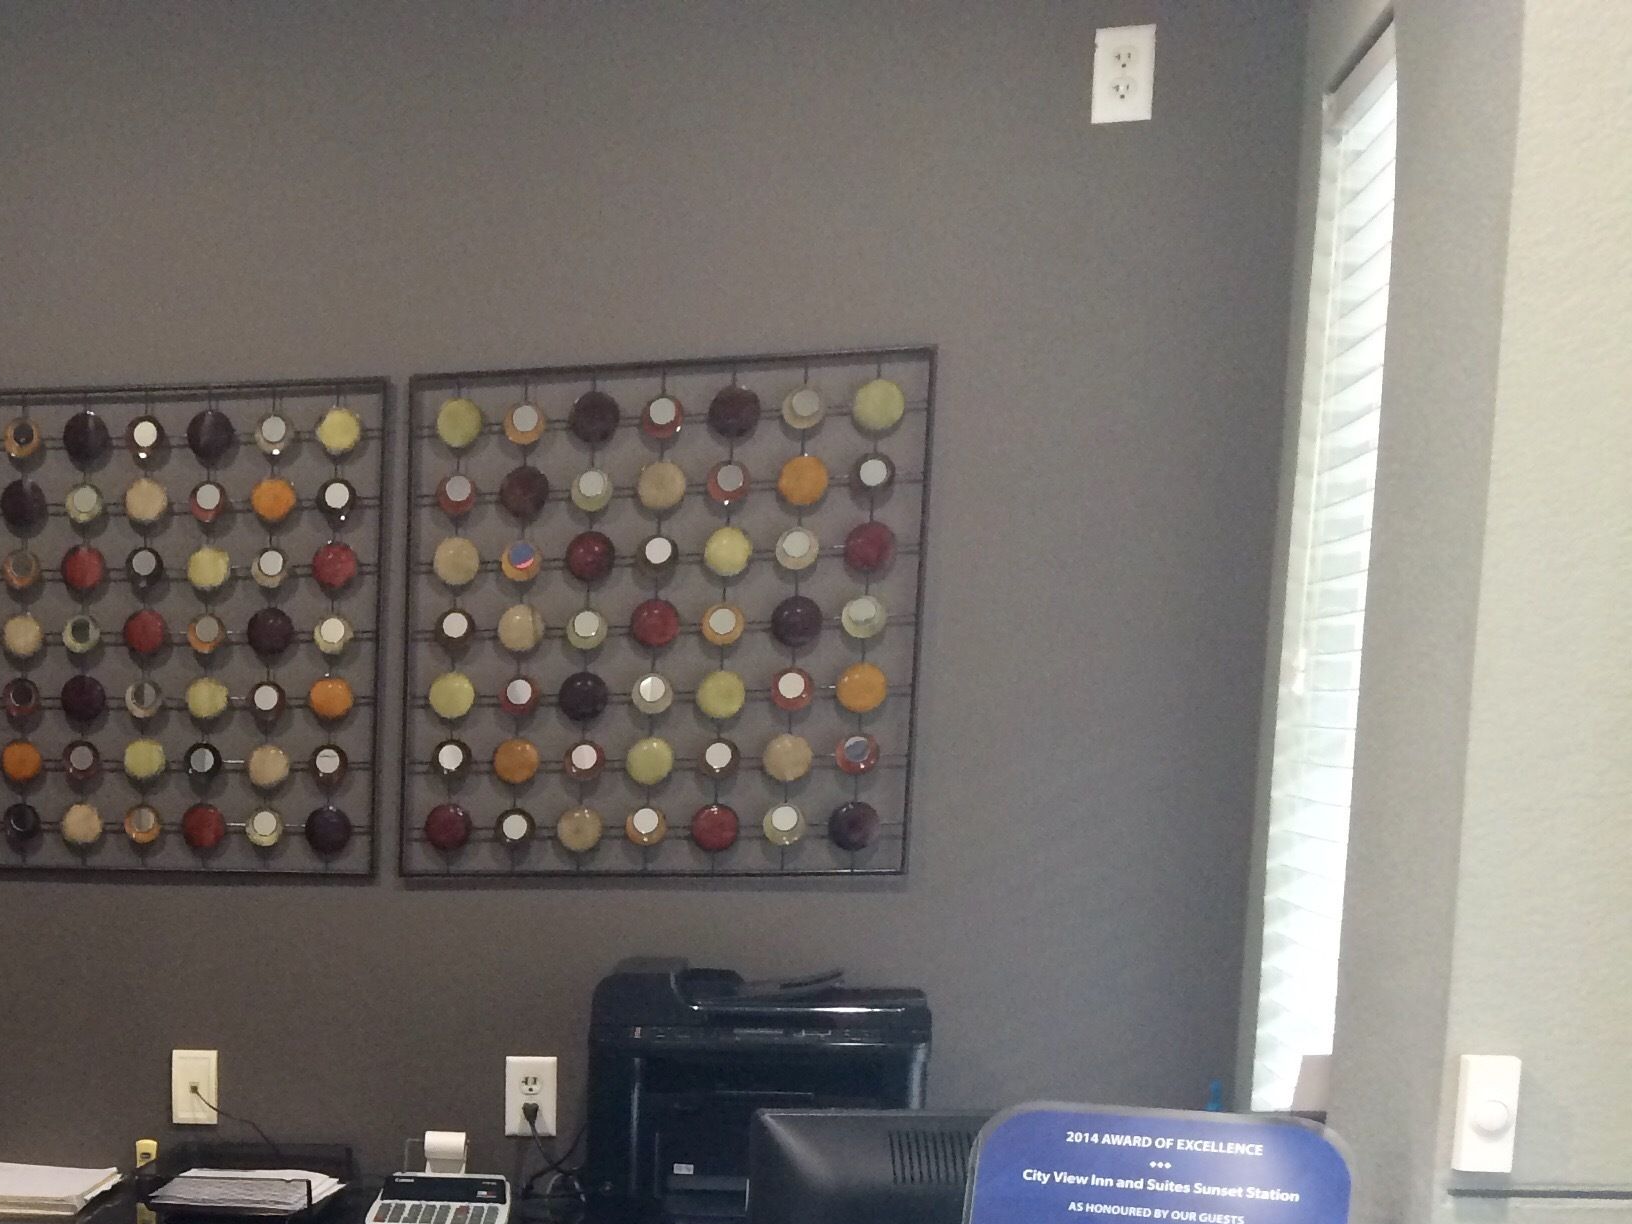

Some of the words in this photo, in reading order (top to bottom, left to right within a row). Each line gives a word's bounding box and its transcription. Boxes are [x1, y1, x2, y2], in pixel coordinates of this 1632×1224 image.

[1065, 1131, 1099, 1144] 2014
[1101, 1133, 1153, 1149] AWARD
[1154, 1137, 1174, 1150] OF
[1176, 1139, 1264, 1157] EXCELLENCE
[1022, 1168, 1051, 1185] City
[1053, 1171, 1088, 1185] View
[1090, 1174, 1113, 1187] Inn
[1115, 1177, 1144, 1190] and
[1146, 1179, 1190, 1194] Suites
[1193, 1182, 1243, 1198] Sunset
[1245, 1186, 1300, 1202] Station
[1067, 1201, 1084, 1213] AS
[1085, 1203, 1152, 1218] HONOURED
[1153, 1208, 1169, 1220] BY
[1171, 1210, 1197, 1223] OUR
